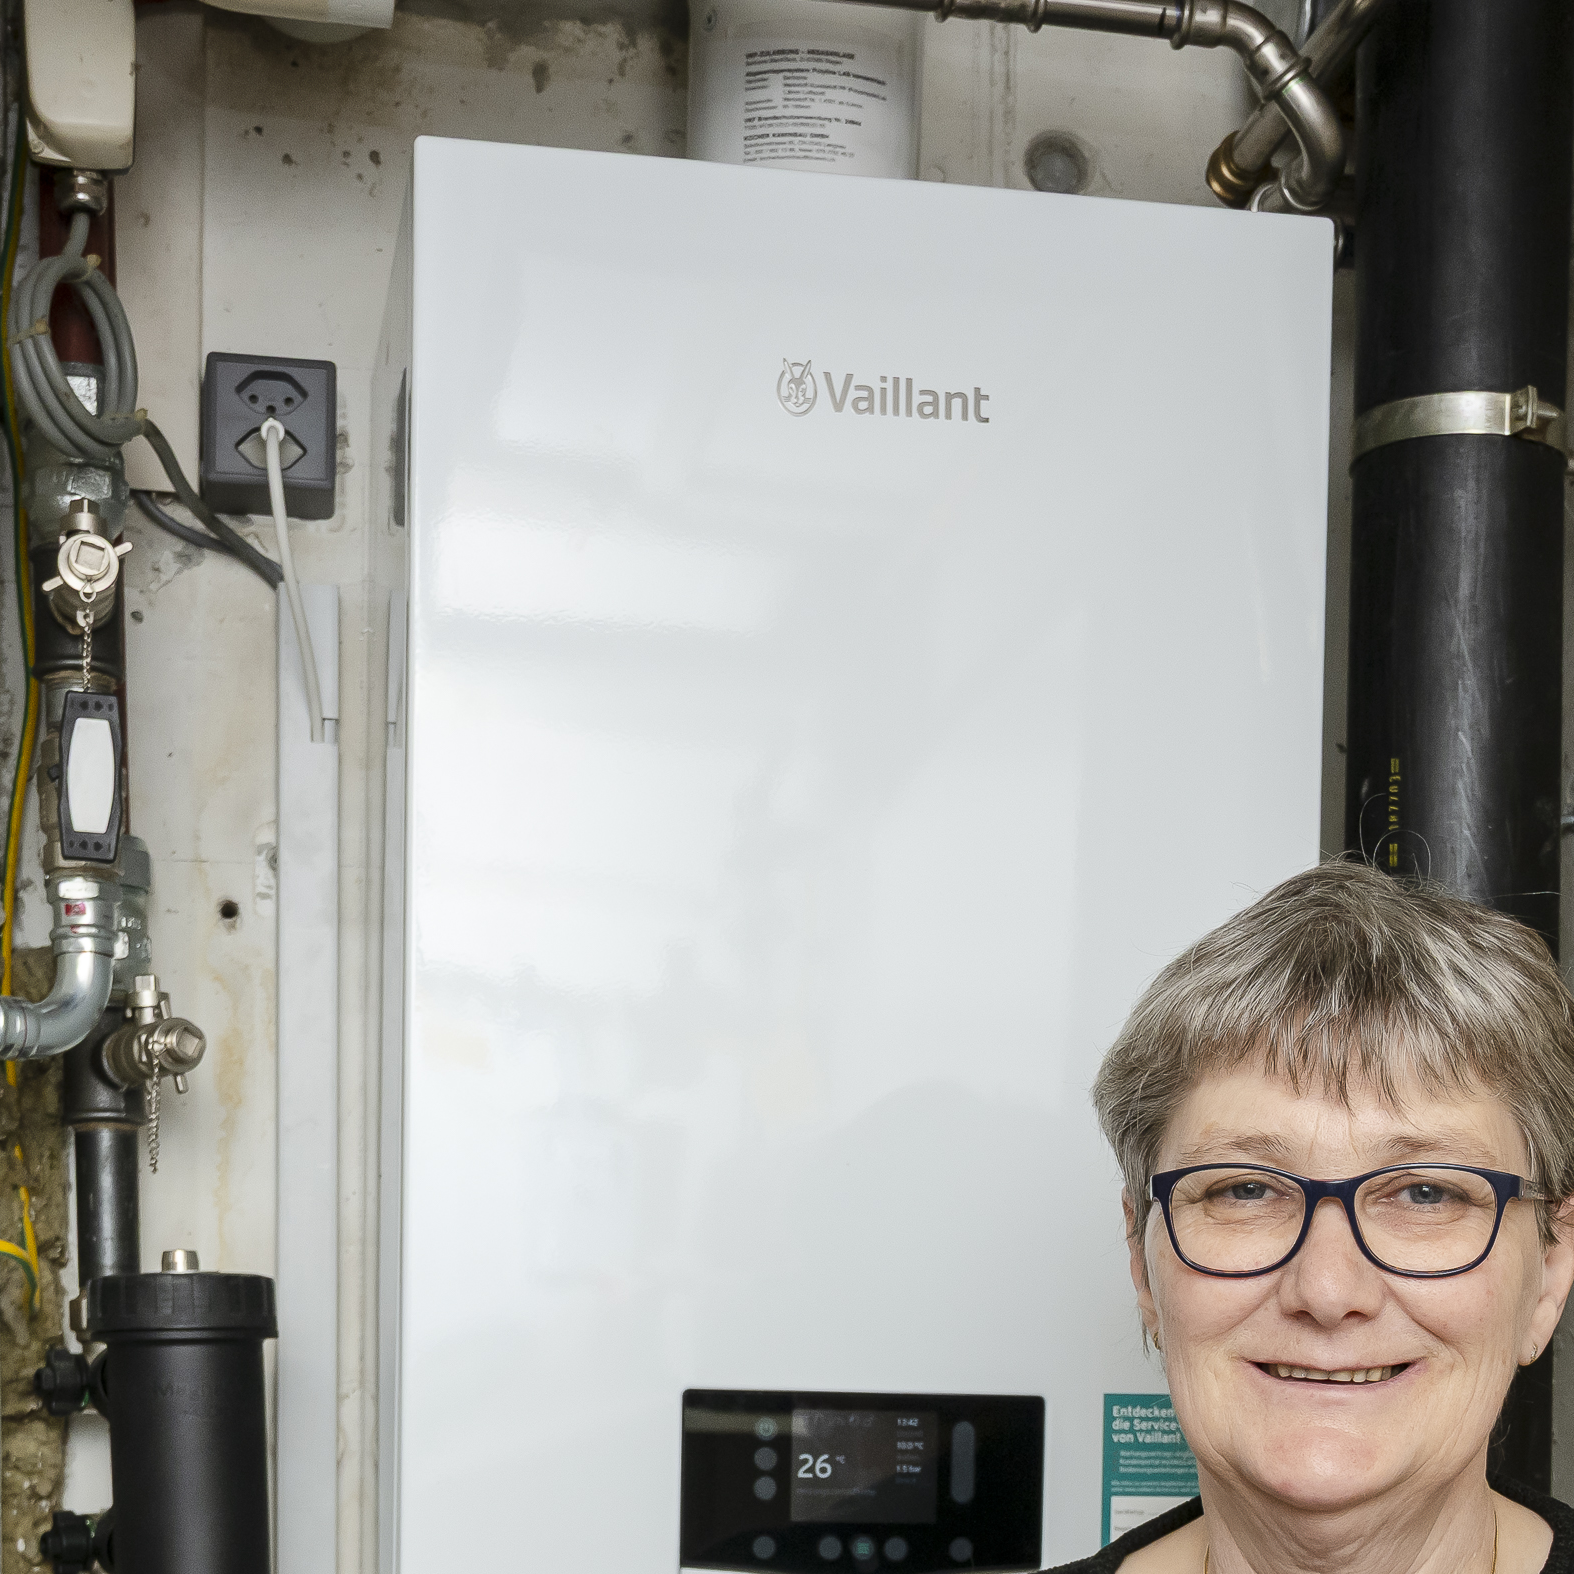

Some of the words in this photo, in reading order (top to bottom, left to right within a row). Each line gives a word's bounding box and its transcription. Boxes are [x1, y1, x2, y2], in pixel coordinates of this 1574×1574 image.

[823, 372, 990, 423] Vaillant
[1112, 1405, 1175, 1418] Entdecken
[1112, 1418, 1131, 1430] die
[1112, 1433, 1134, 1443] von
[1136, 1432, 1181, 1444] Vaillant
[797, 1454, 832, 1478] 26
